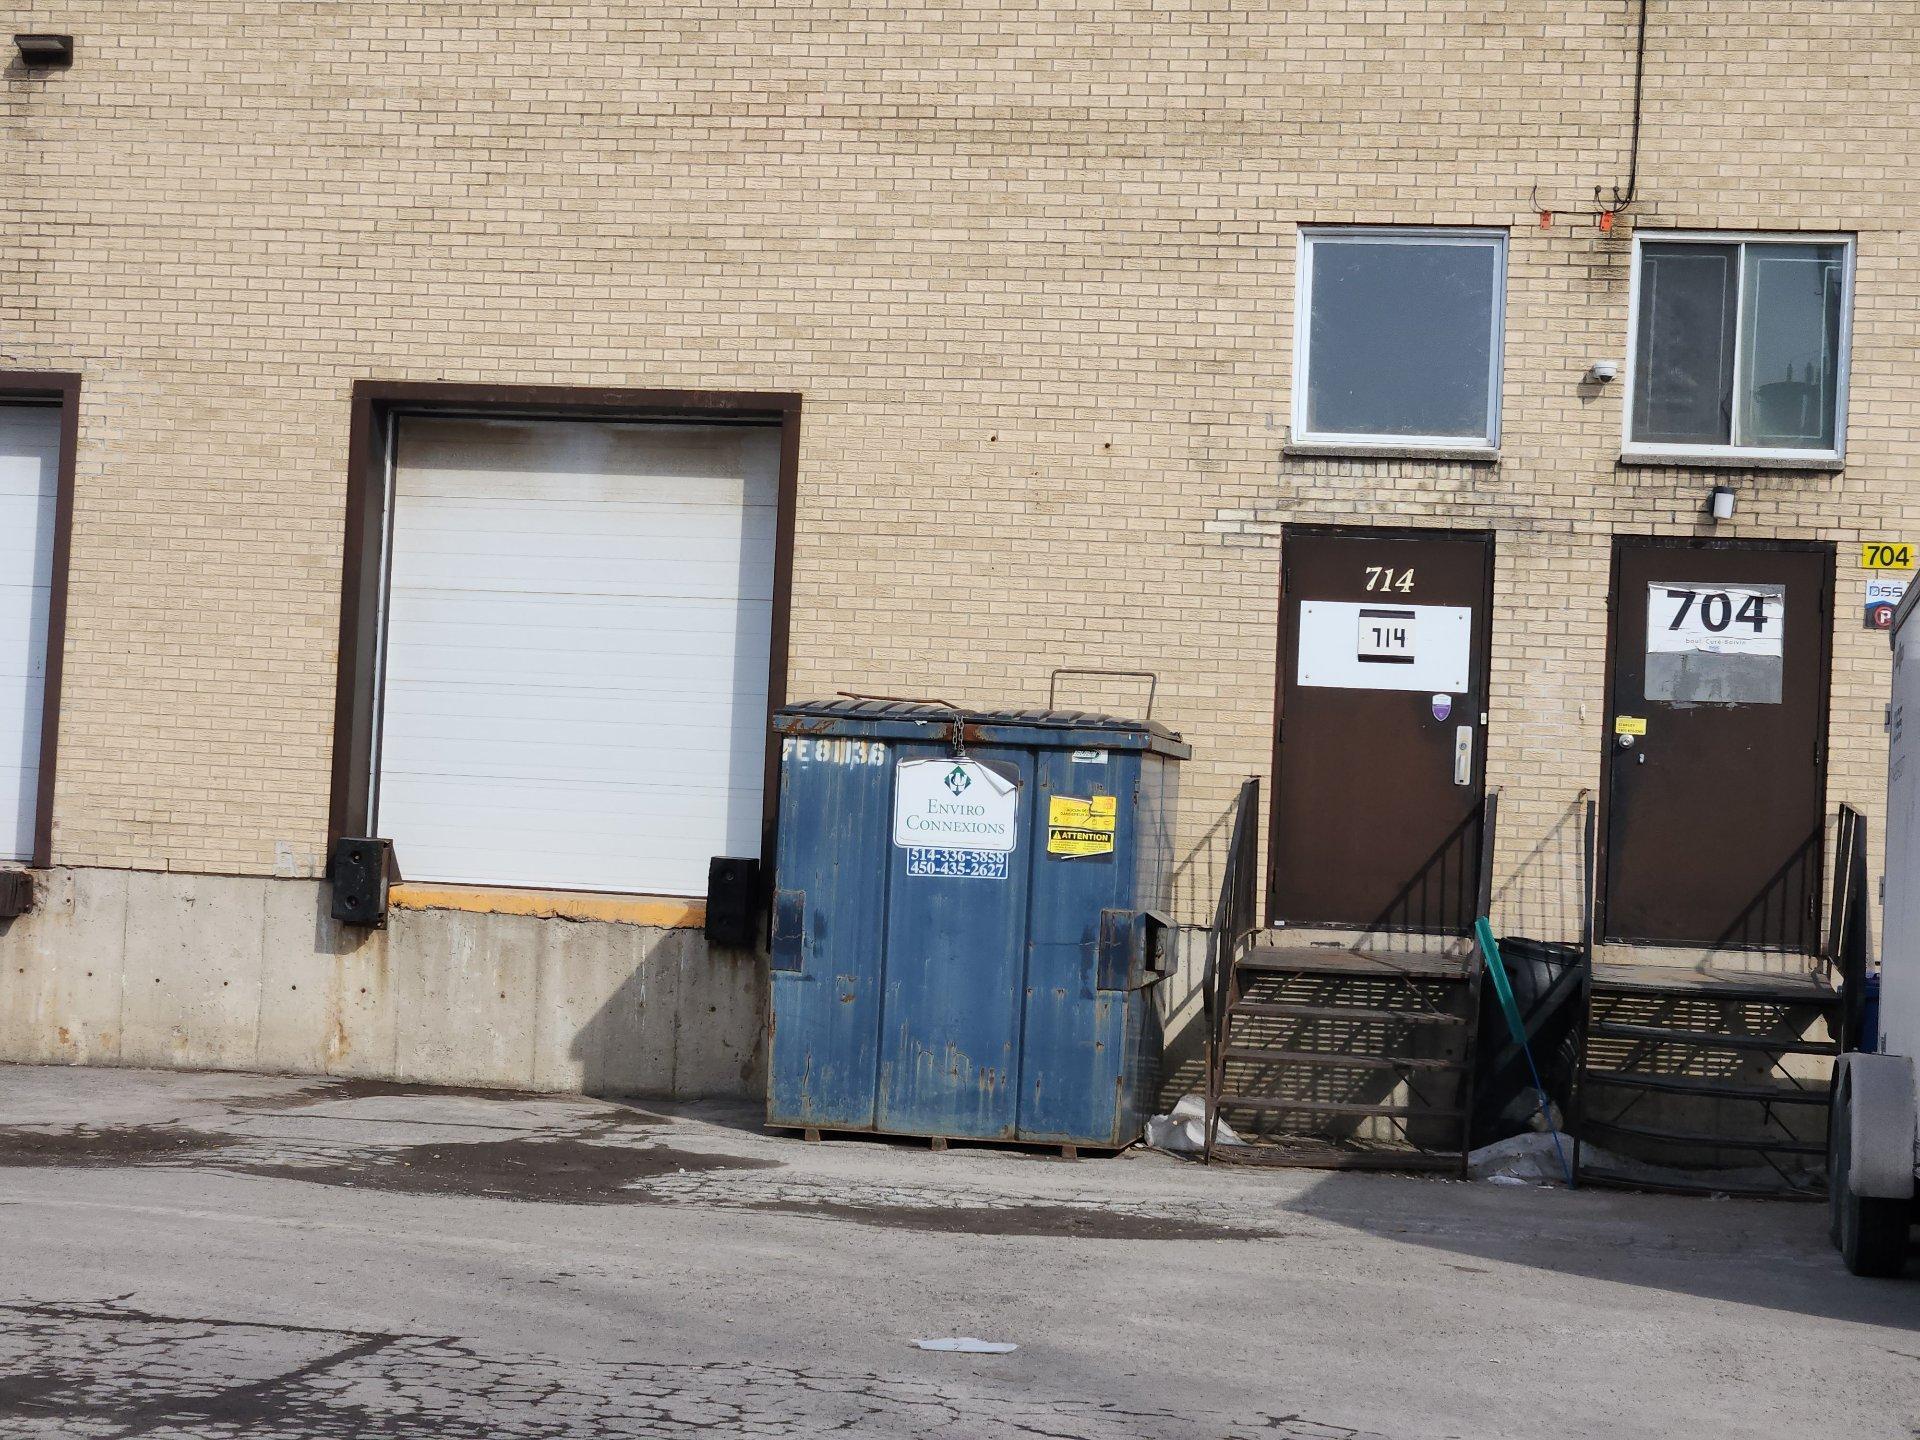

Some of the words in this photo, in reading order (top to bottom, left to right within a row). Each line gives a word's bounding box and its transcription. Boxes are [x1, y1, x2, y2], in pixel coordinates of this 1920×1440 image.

[1867, 545, 1909, 566] 704
[1365, 566, 1415, 593] 714
[1869, 585, 1903, 597] DSS
[1667, 589, 1768, 633] 704
[1372, 627, 1406, 648] 714
[782, 738, 811, 762] FE
[1062, 831, 1108, 841] ATTENTION
[910, 847, 1005, 863] 514-336-5858
[910, 860, 1004, 877] 450-435-2627
